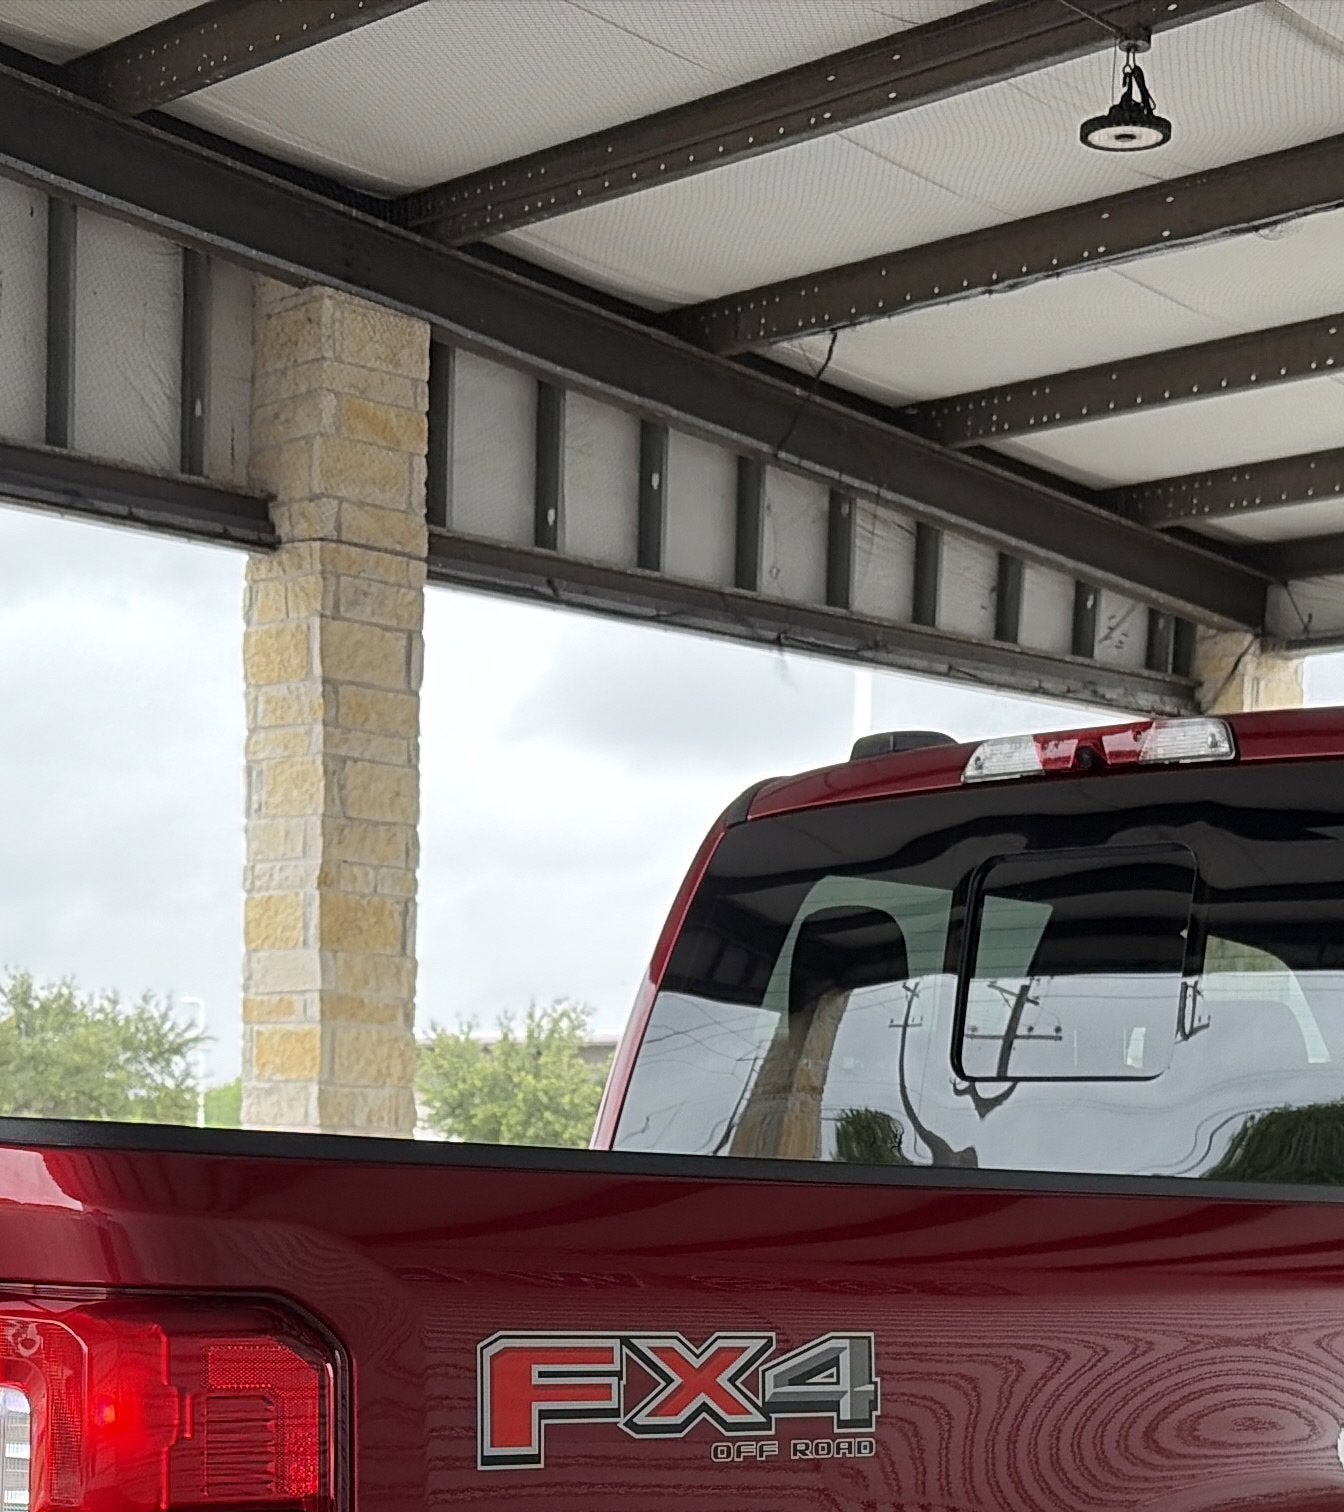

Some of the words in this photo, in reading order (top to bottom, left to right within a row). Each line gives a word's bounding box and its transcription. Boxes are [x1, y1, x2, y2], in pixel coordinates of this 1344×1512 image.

[477, 1331, 880, 1470] FX4
[710, 1439, 778, 1462] OFF
[790, 1437, 876, 1460] ROAD
